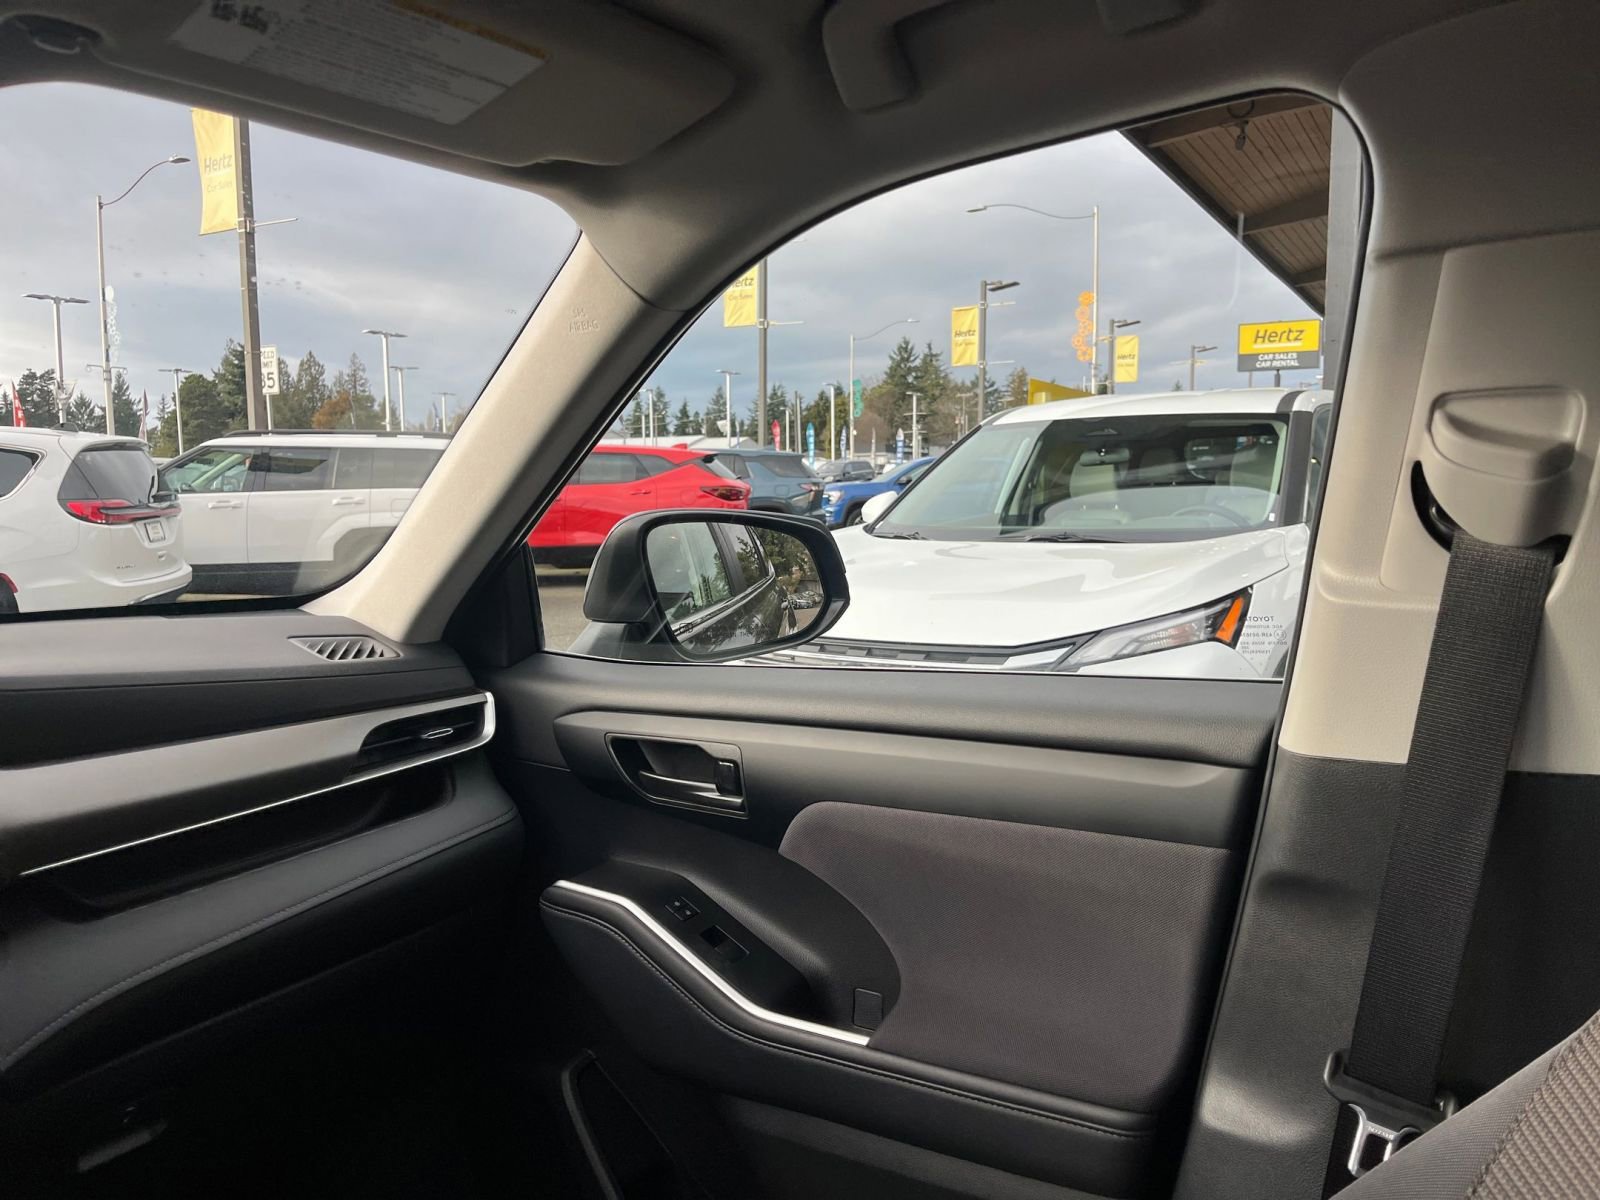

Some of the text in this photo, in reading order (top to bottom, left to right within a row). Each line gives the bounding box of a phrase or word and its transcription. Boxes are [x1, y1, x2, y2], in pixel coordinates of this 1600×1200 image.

[204, 153, 232, 173] Hertz
[732, 276, 754, 288] ertz
[1254, 328, 1305, 344] Hertz
[1258, 352, 1298, 361] CAR SALES
[1272, 359, 1300, 367] RENTAL
